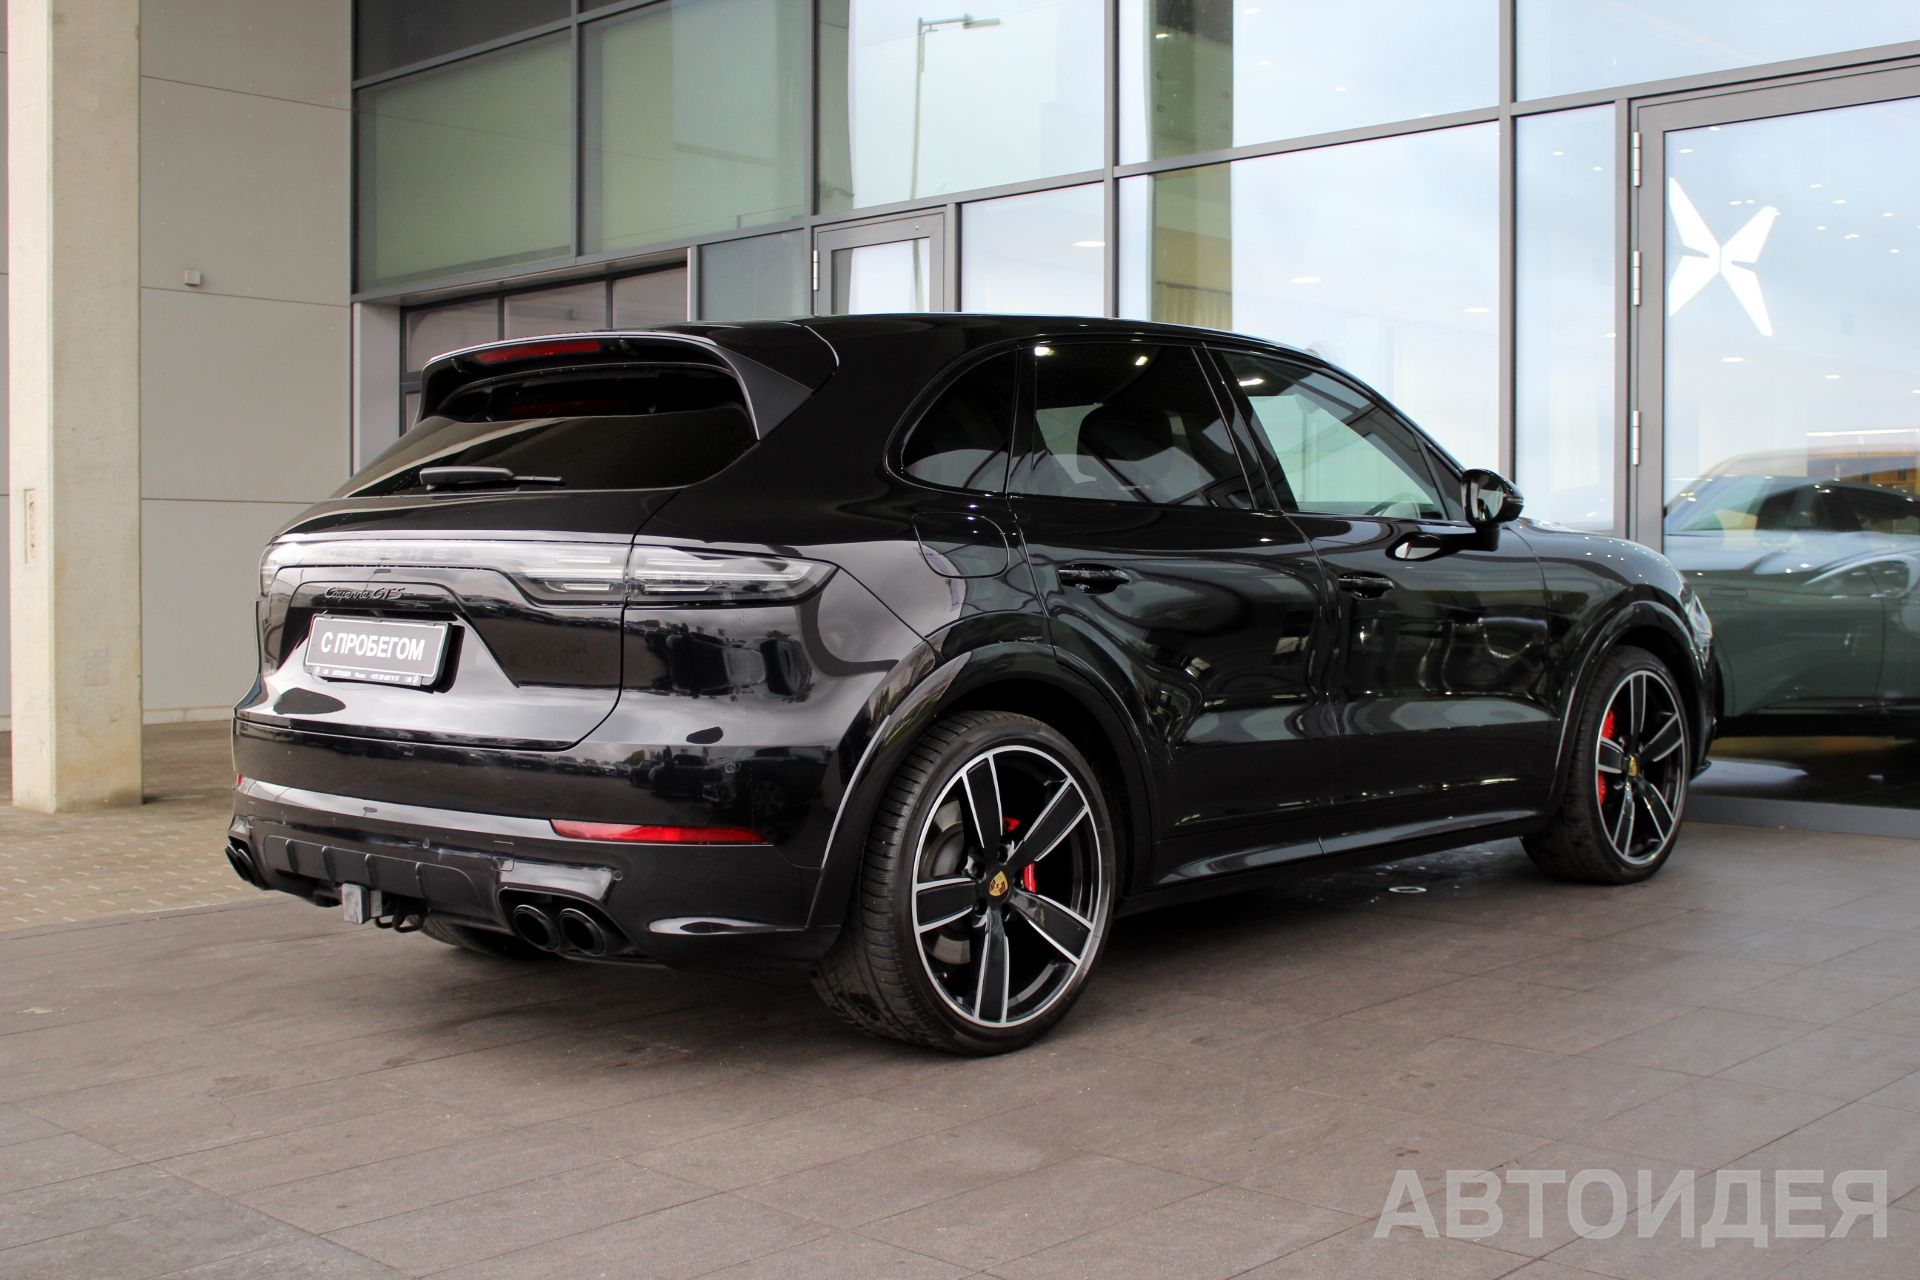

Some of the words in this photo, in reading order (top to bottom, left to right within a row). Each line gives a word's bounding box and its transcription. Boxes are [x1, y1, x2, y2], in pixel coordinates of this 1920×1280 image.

[325, 587, 370, 600] Cayenne
[373, 587, 405, 600] GTS
[321, 632, 332, 653] С
[335, 632, 425, 661] ПРОБЕГОМ
